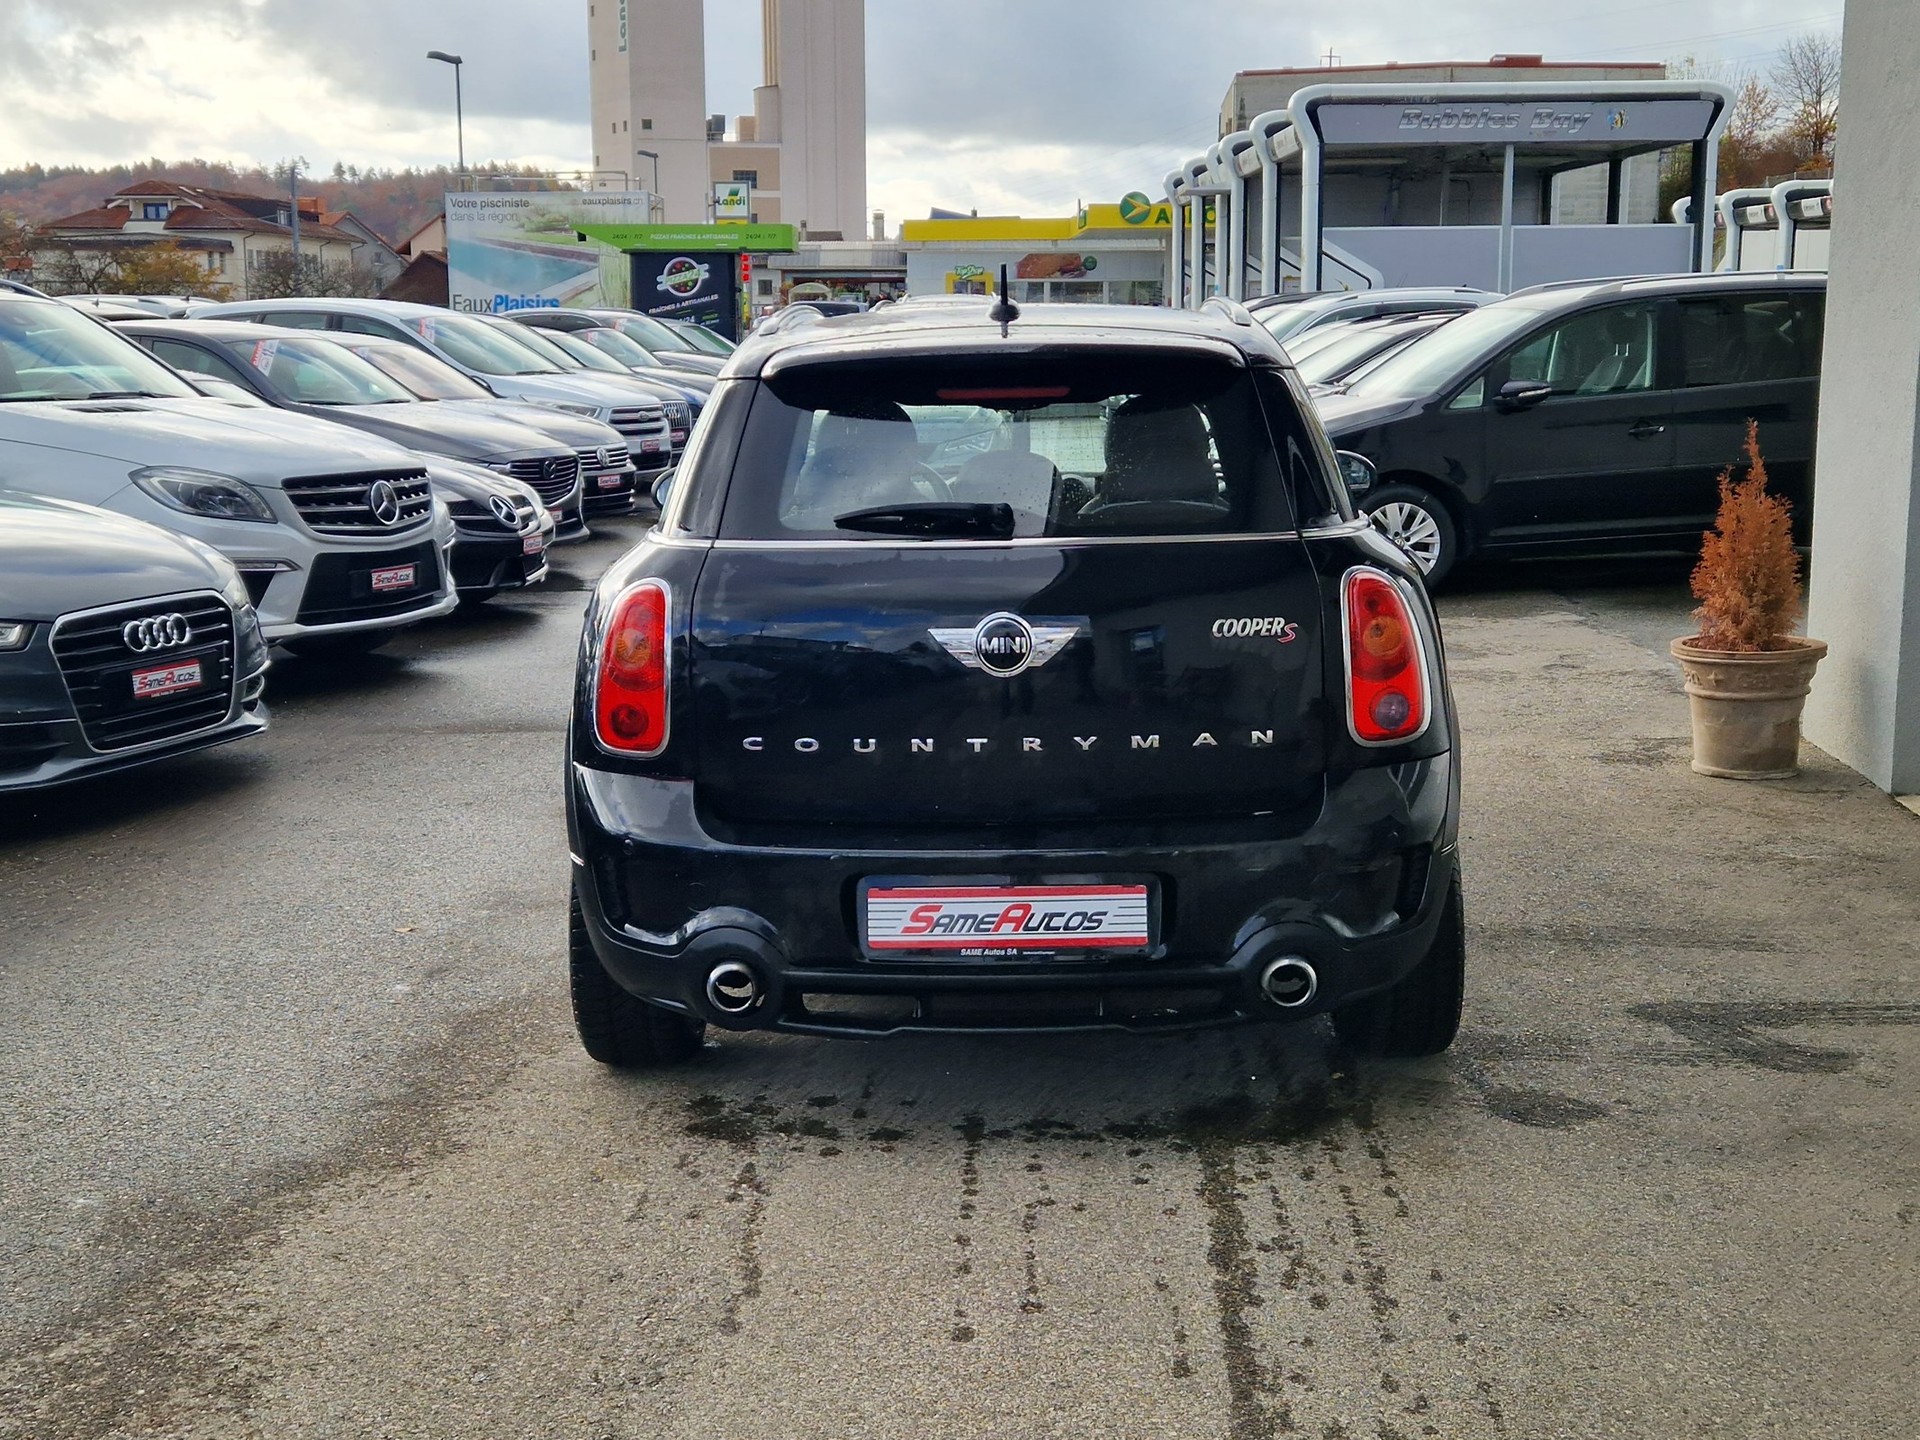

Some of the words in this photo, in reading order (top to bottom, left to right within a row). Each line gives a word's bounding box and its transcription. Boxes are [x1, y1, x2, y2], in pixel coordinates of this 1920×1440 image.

[618, 0, 627, 52] Lan
[1399, 107, 1520, 129] Bubbles
[1530, 107, 1592, 134] Bay
[450, 198, 478, 209] Votre
[480, 198, 530, 210] pisciniste
[718, 196, 746, 206] Landi
[450, 211, 474, 221] dans
[477, 211, 486, 221] la
[980, 636, 1028, 654] MINI
[742, 729, 1275, 754] COUNTRYMAN
[960, 948, 982, 956] SAME
[983, 947, 1005, 956] Autos
[1006, 947, 1018, 956] SA
